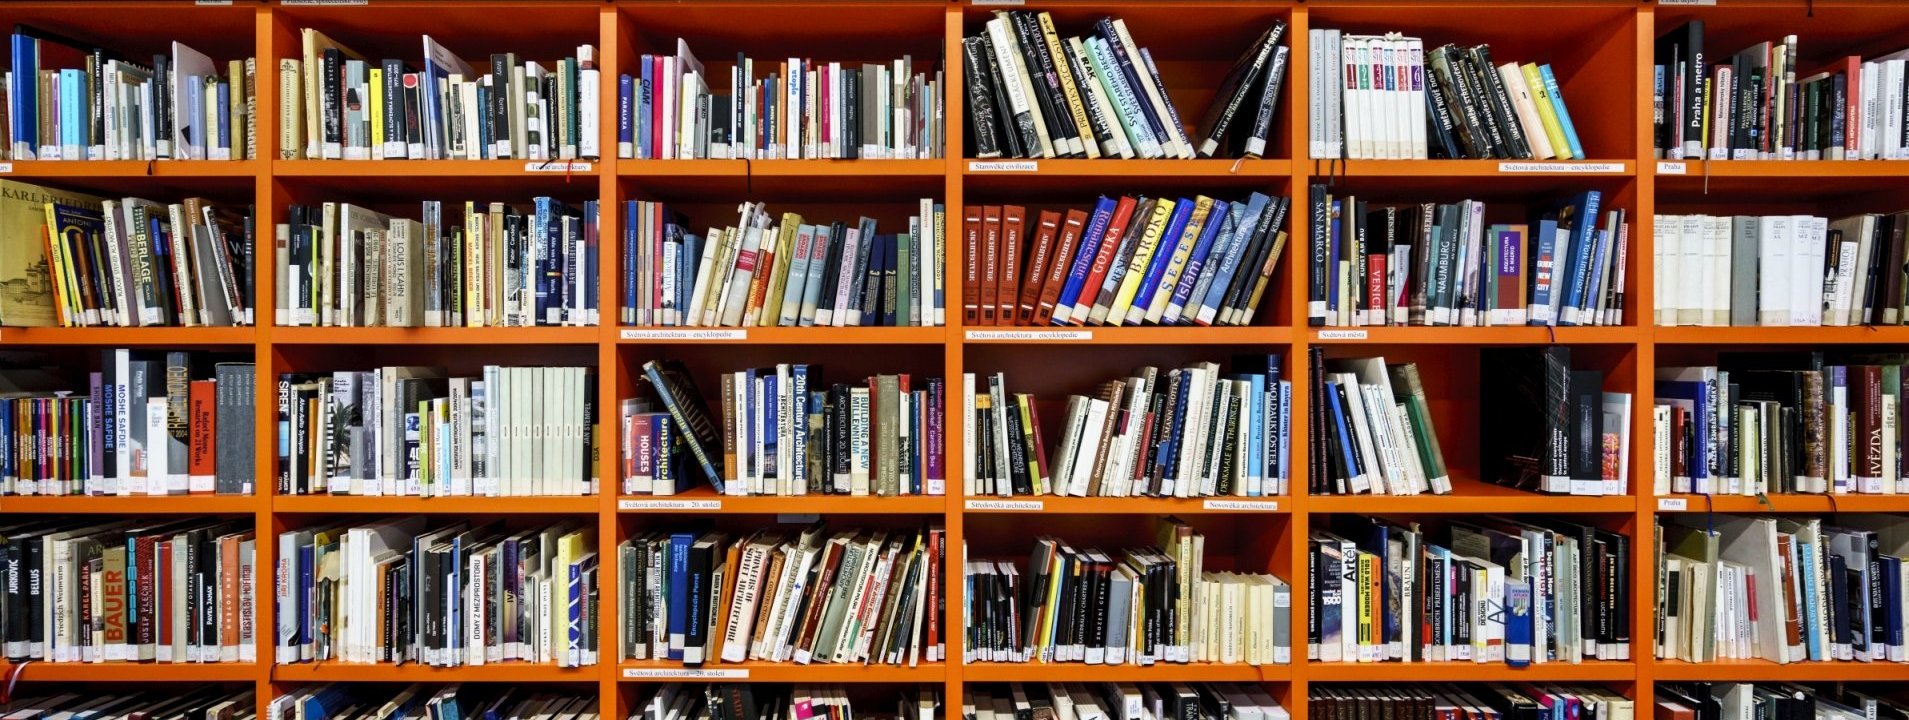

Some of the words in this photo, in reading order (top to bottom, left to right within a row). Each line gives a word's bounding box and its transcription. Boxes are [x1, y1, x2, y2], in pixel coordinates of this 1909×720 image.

[1051, 39, 1073, 86] VĚČNOSTI
[1081, 57, 1096, 79] IRAK
[1427, 69, 1437, 87] DOBY
[1694, 53, 1704, 85] metro
[1067, 87, 1087, 128] PŘÍBYTKY
[1434, 88, 1445, 107] NOVÉ
[1691, 97, 1702, 127] Praha
[1440, 107, 1453, 130] UMĚNÍ
[1471, 104, 1481, 127] UMĚNÍ
[1571, 164, 1610, 172] encyklopedie
[1315, 203, 1324, 222] SAN
[1423, 204, 1432, 232] BERLIN
[1075, 210, 1111, 280] Romanesque
[1129, 205, 1168, 274] BAROKO
[1315, 224, 1325, 262] MARCO
[1360, 244, 1365, 254] AM
[1584, 225, 1593, 241] New
[137, 234, 152, 283] BERLAGE
[1007, 230, 1016, 281] ARCHITECTURE
[1032, 233, 1050, 283] ARCHITECTURE
[1052, 231, 1073, 281] ARCHITECTURE
[1091, 227, 1120, 273] GOTIKA
[1220, 227, 1248, 274] Architektura
[1580, 243, 1590, 260] York
[665, 244, 673, 291] Architektura
[1175, 260, 1201, 300] Islám
[1437, 241, 1450, 293] NAUMBURG
[1576, 262, 1588, 293] Interiors
[115, 277, 123, 297] RUDOLF
[1372, 270, 1382, 310] VENICE
[692, 331, 732, 340] encyklopedie
[1038, 332, 1077, 340] encyklopedie
[105, 385, 113, 413] MOSHE
[118, 385, 126, 413] MOSHE
[279, 381, 289, 413] SIREN
[795, 375, 807, 393] 20th
[1282, 385, 1290, 408] Bayern
[194, 400, 202, 425] Remarks
[583, 402, 591, 433] STEMPEL
[795, 395, 807, 429] Century
[852, 396, 861, 454] MILLENNIUM
[860, 396, 868, 438] BUILDING
[1224, 397, 1239, 441] THÜRINGEN
[1269, 382, 1278, 466] MOLDAUKLÖSTER
[105, 416, 113, 448] SAFDIE
[118, 417, 126, 449] SAFDIE
[195, 428, 200, 437] on
[1226, 443, 1233, 451] IN
[640, 435, 650, 472] HOUSES
[795, 430, 807, 480] Architecture
[861, 448, 869, 469] NEW
[1867, 428, 1881, 478] HVĚZDA
[1219, 453, 1232, 492] DENKMALE
[971, 501, 1002, 509] Středověká
[8, 559, 18, 594] JURKOVIČ
[738, 548, 753, 577] SOVIET
[747, 550, 763, 588] PIONEERS
[1342, 547, 1355, 582] Artěl
[1433, 561, 1441, 587] UMĚNÍ
[1805, 546, 1815, 588] DIVADLO
[141, 575, 149, 612] PLEČNIK
[473, 560, 481, 613] MEZIPROSTORU
[745, 590, 754, 603] OF
[1097, 582, 1106, 604] GÉNIA
[1433, 588, 1441, 609] PŘÍBĚH
[106, 571, 123, 640] BAUER
[690, 595, 699, 635] Encyclopédie
[727, 578, 747, 643] ARCHITECTURE
[1478, 600, 1486, 626] DESIGNU
[1808, 590, 1818, 631] NÁRODNÍ
[1096, 608, 1104, 640] ZROZENÍ
[629, 670, 652, 678] Světová
[653, 670, 690, 678] architektura
[708, 670, 724, 678] století
